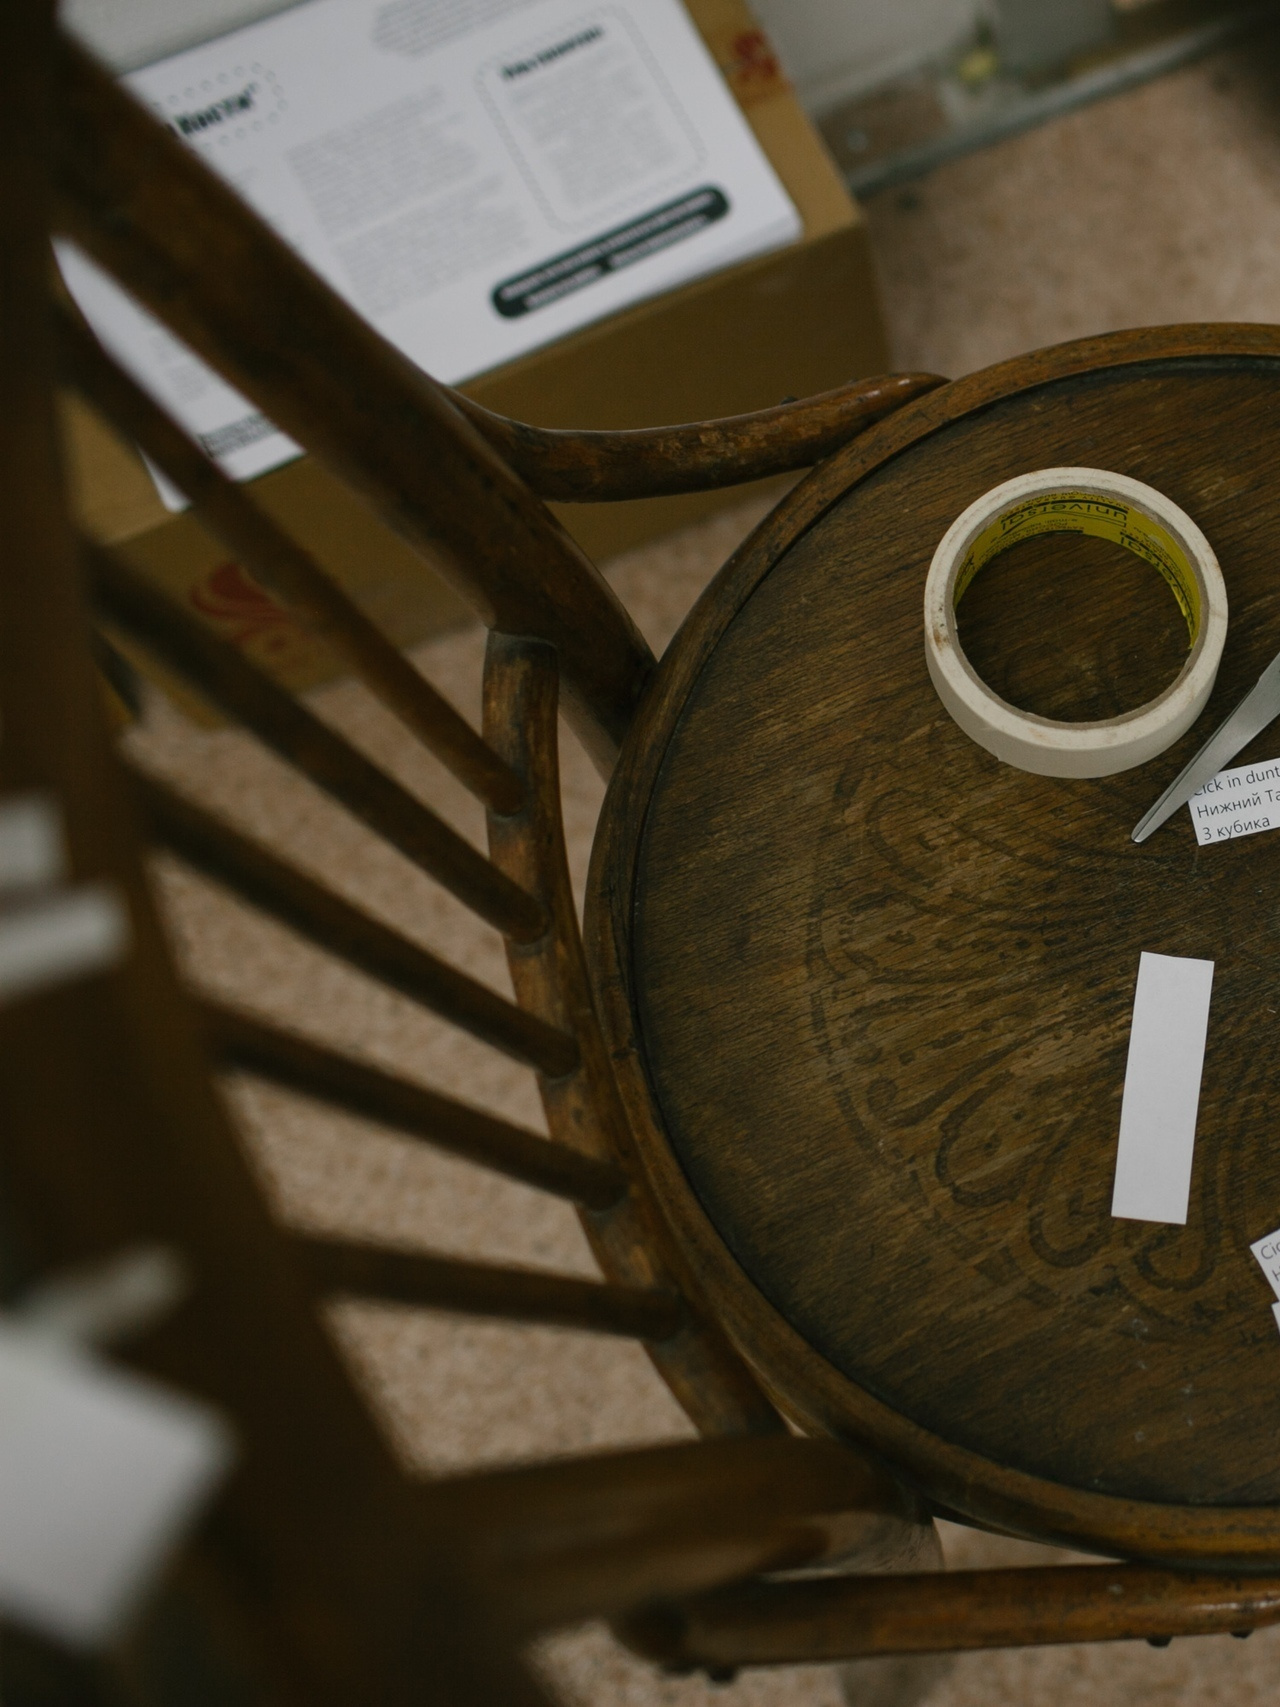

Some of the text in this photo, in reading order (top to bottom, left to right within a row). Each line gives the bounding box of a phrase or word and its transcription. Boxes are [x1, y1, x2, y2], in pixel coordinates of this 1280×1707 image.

[1001, 503, 1127, 530] universal
[1226, 775, 1241, 788] in
[1245, 766, 1280, 785] dunt
[1196, 792, 1262, 819] Нижний
[1203, 816, 1270, 841] 3 кубика
